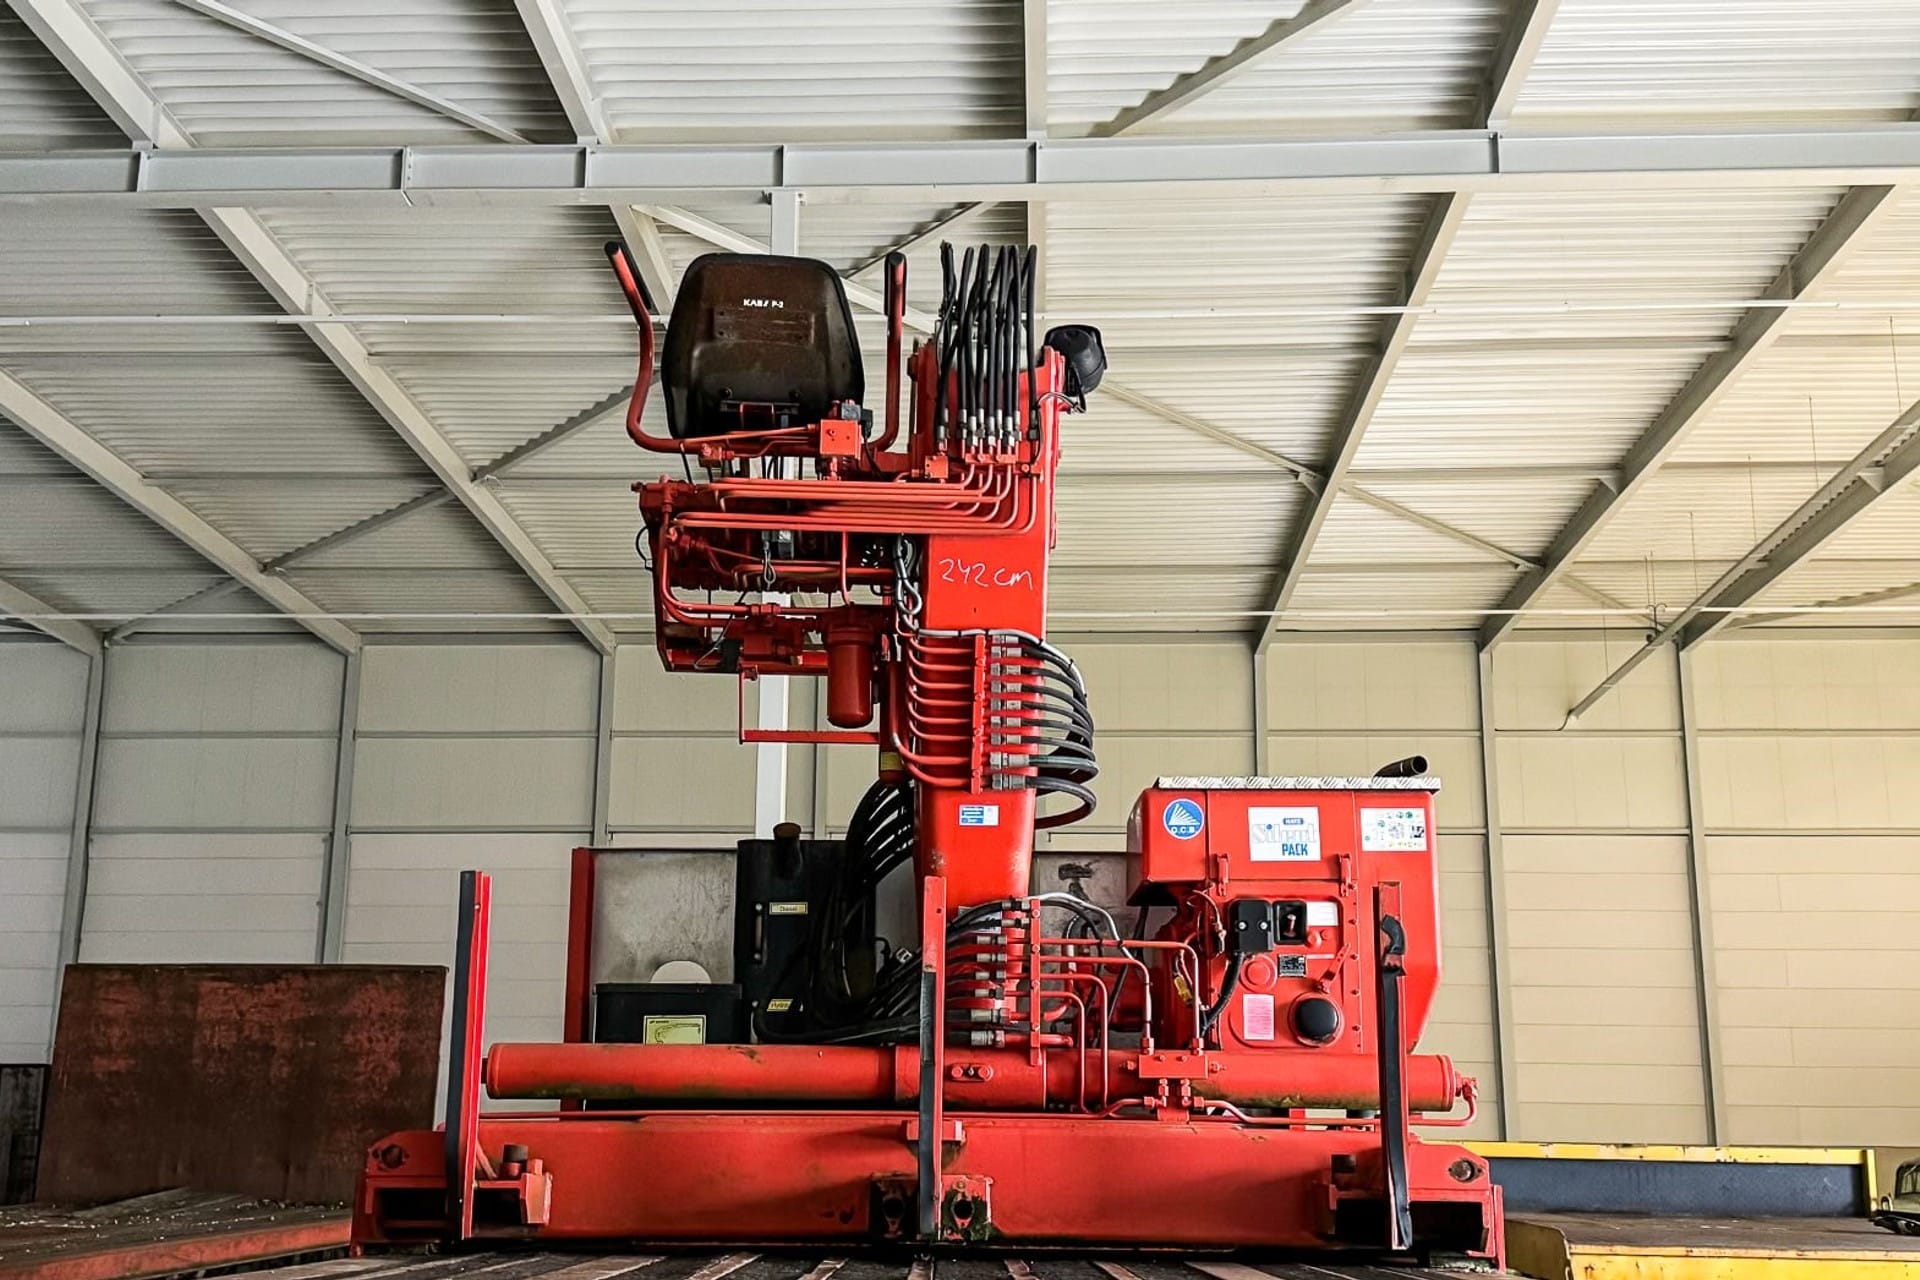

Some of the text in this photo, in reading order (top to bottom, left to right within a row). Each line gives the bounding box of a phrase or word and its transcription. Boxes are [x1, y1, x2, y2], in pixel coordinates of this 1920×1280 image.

[939, 558, 1033, 591] 242 cm
[1281, 843, 1308, 856] PACK
